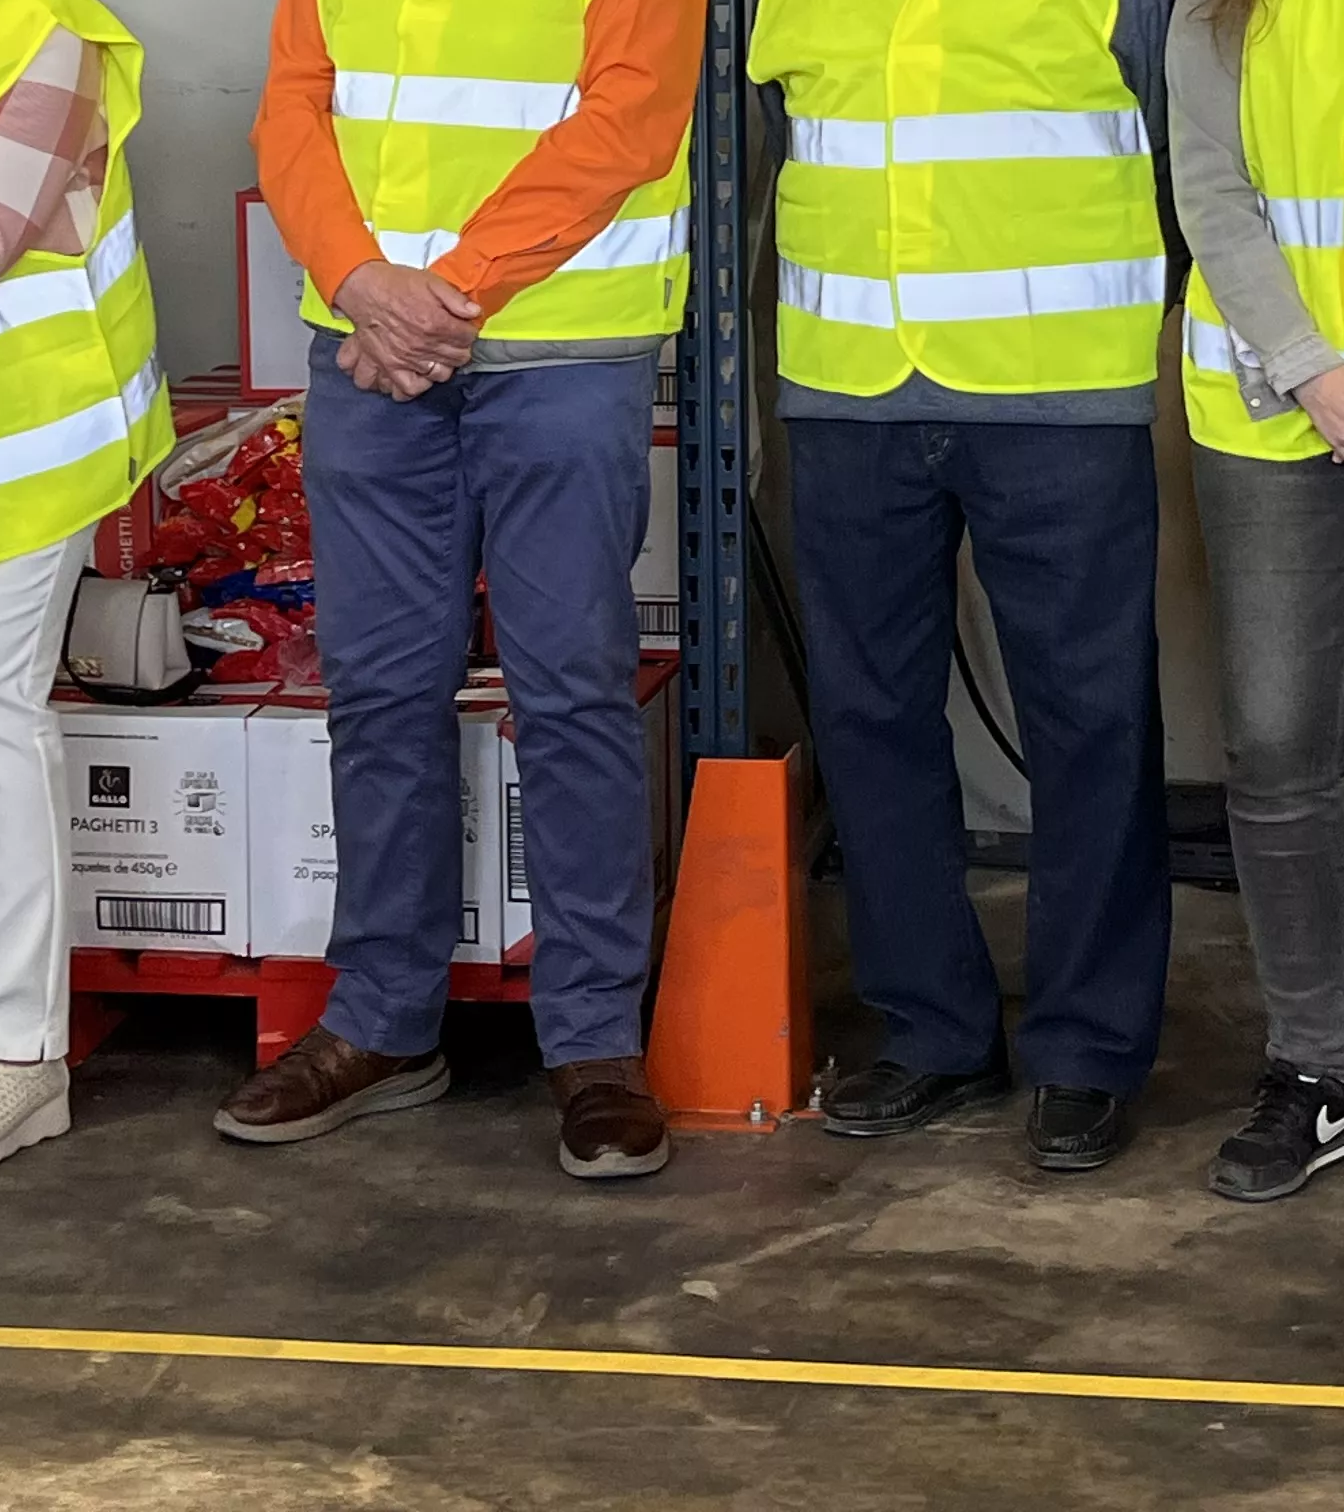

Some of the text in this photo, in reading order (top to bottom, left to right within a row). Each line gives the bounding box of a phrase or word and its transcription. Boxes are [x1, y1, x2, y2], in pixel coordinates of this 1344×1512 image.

[118, 516, 134, 581] AGHETTI
[91, 794, 128, 805] GALLO
[70, 816, 159, 834] PAGHETTI 3
[293, 866, 309, 879] 20
